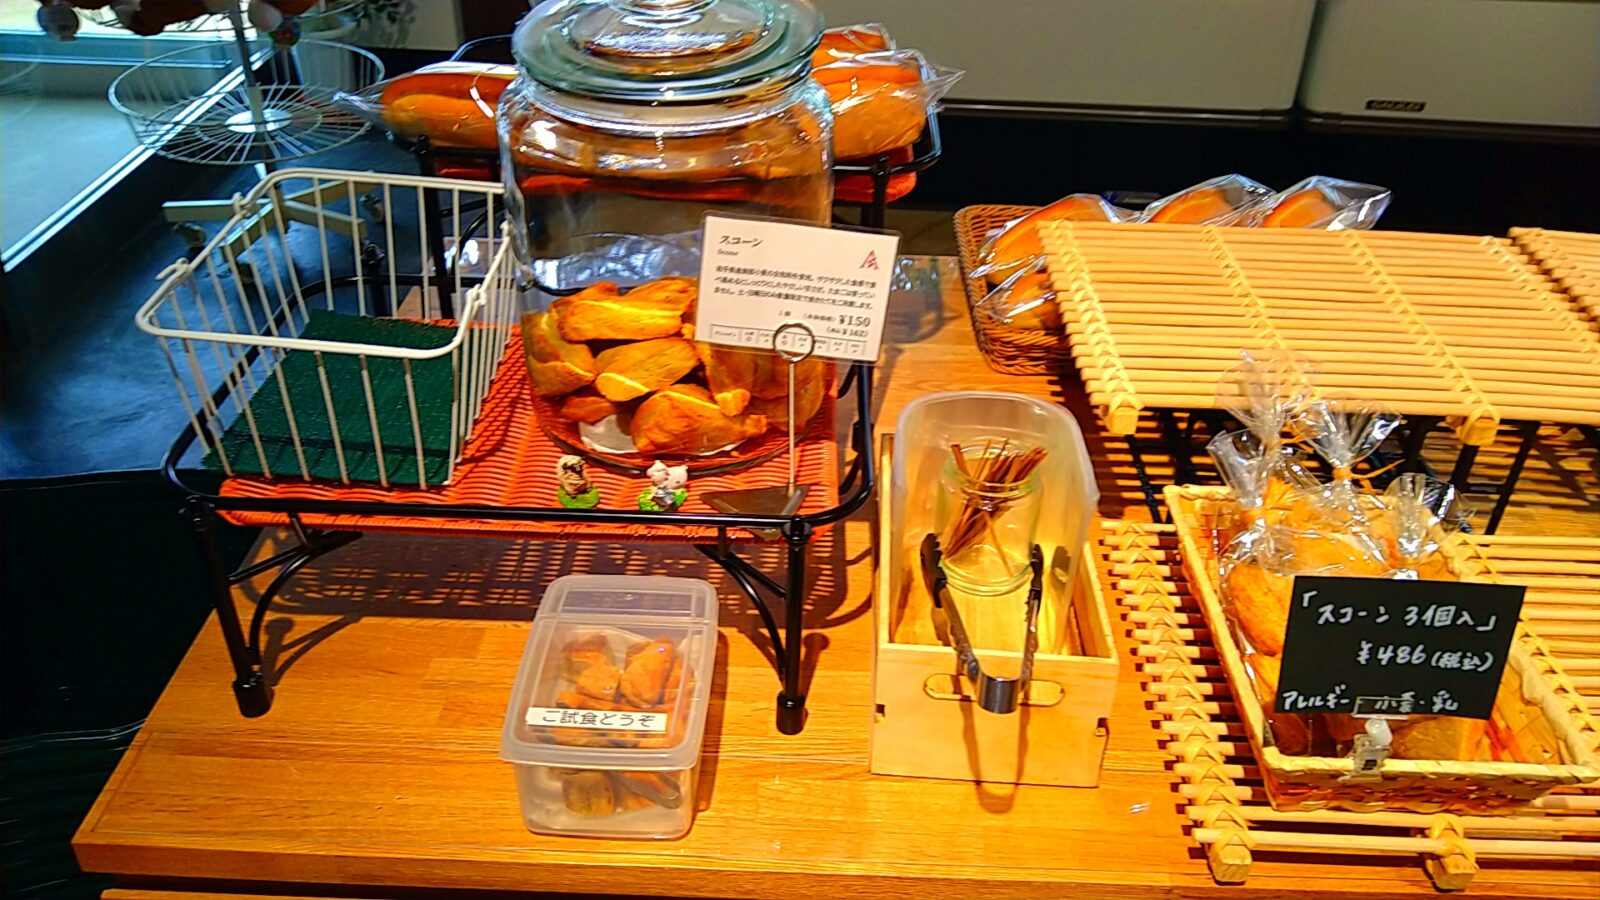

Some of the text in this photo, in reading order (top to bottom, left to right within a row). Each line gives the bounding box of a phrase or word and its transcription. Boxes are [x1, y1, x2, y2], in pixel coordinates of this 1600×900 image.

[719, 235, 763, 248] スコーン
[839, 314, 871, 328] ¥150
[1282, 684, 1350, 711] アレルギー
[542, 709, 656, 728] ご試食どうぞ
